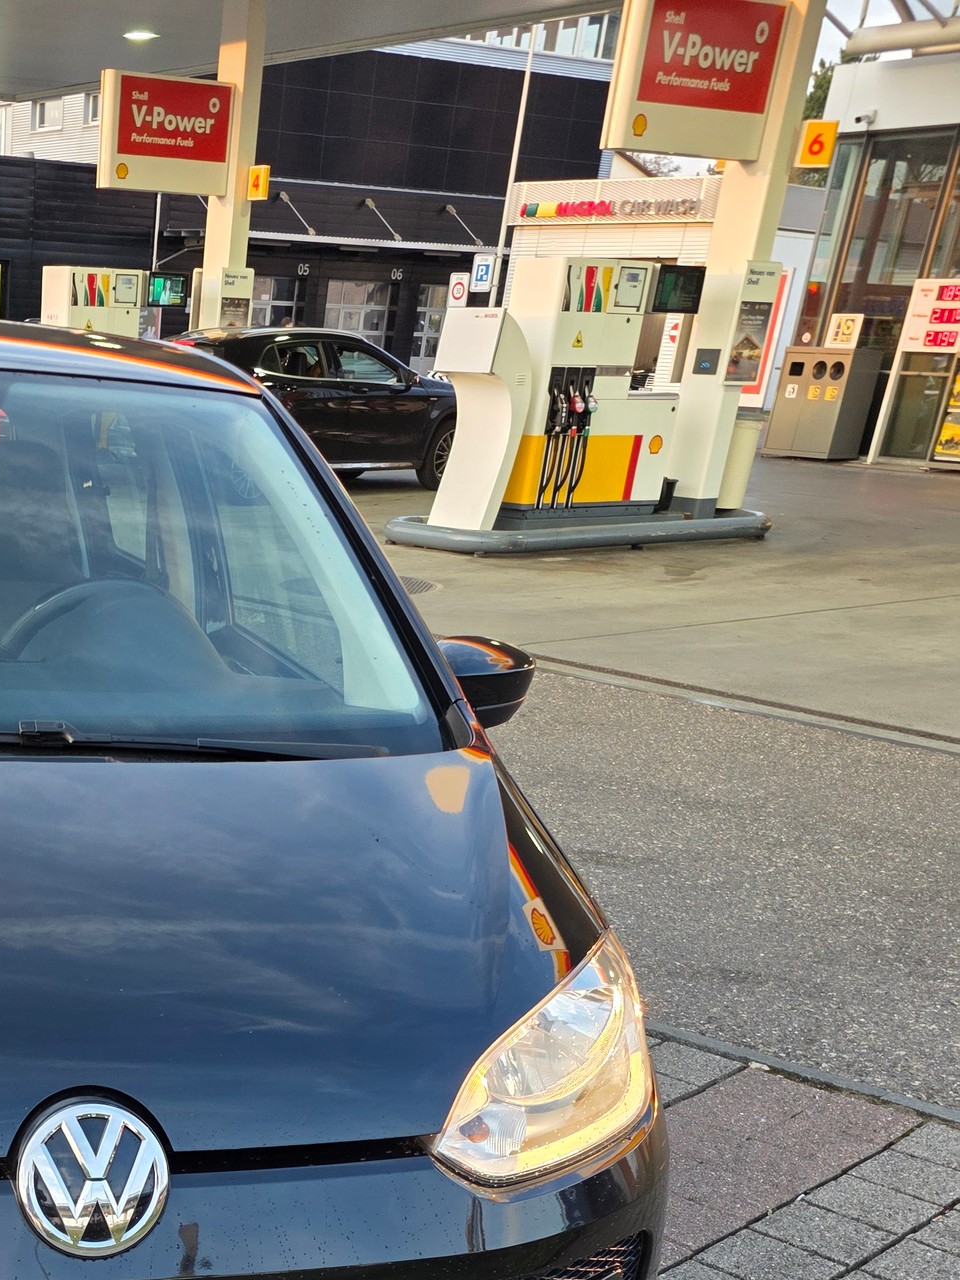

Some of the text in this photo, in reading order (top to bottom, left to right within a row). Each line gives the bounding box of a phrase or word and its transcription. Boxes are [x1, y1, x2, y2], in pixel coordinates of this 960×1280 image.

[665, 11, 686, 25] Shell
[663, 30, 759, 74] V-Power
[655, 72, 731, 92] Performance Fuels
[131, 91, 149, 101] Shell
[131, 104, 215, 134] V-Power
[130, 133, 194, 148] Performance Fuels
[808, 133, 825, 156] 6
[252, 174, 260, 191] 4
[556, 198, 702, 217] MIGROL CAR WASH
[297, 263, 310, 276] 05
[390, 268, 403, 280] 06
